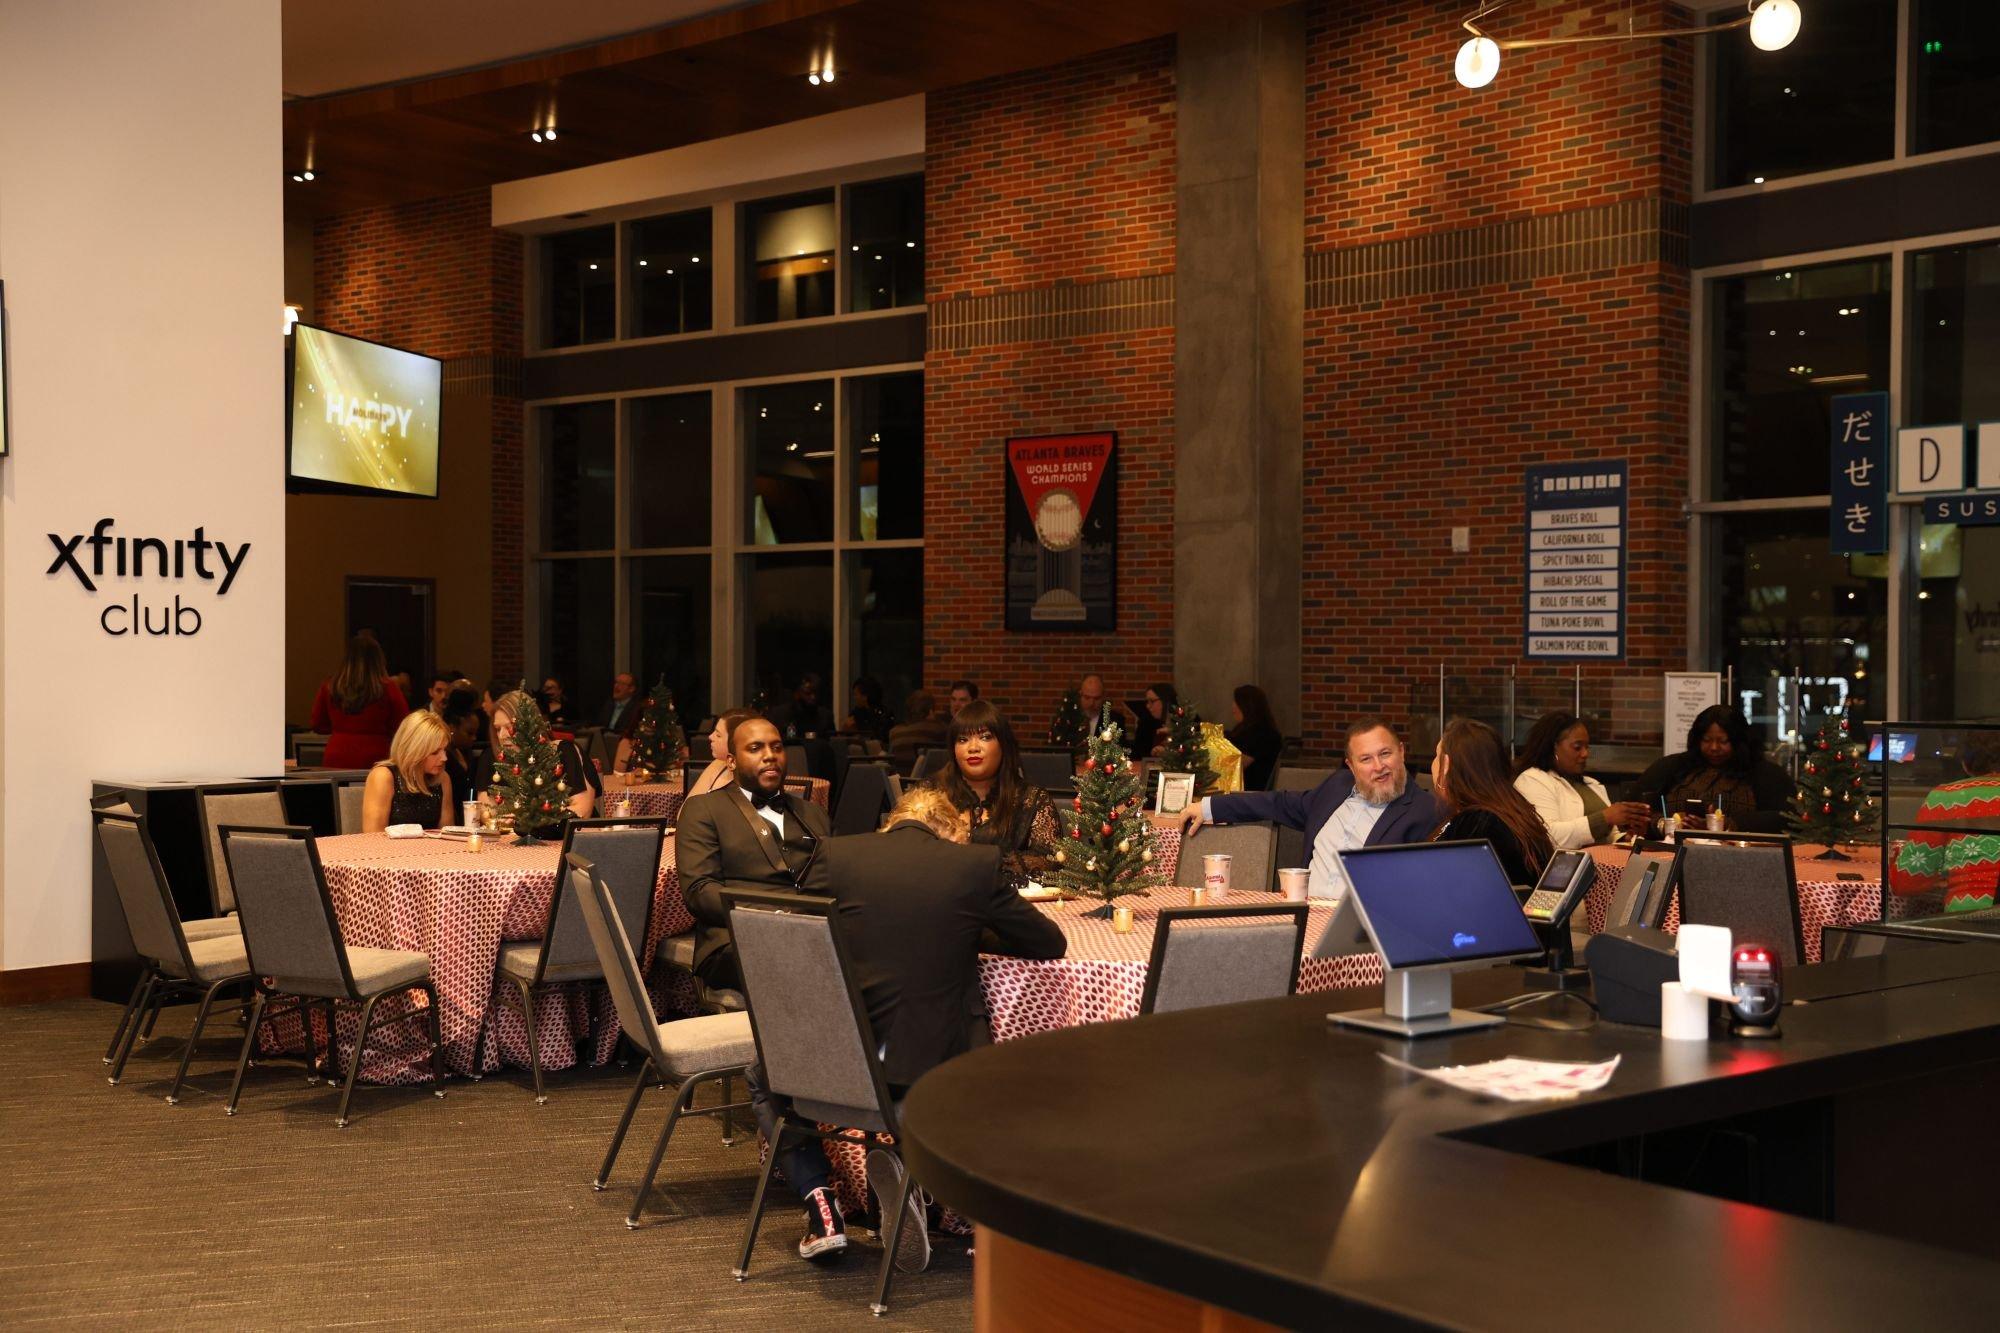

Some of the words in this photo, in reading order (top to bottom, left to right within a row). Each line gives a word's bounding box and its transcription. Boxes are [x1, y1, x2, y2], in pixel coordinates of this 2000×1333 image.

[325, 391, 413, 438] HAPPY
[1015, 446, 1060, 462] ATLANTA
[1064, 444, 1105, 459] BRAVES
[1026, 463, 1059, 474] WORLD
[1062, 461, 1094, 473] SERIES
[1841, 410, 1874, 534] だせき
[1031, 472, 1088, 485] CHAMPIONS
[1550, 512, 1579, 524] BRAVES
[1580, 512, 1598, 523] ROLL
[1543, 534, 1585, 546] CALIFORNIA
[1586, 532, 1605, 544] ROLL
[46, 517, 252, 596] xfinity
[1542, 554, 1564, 567] SPICY
[1565, 554, 1584, 566] TUNA
[1586, 553, 1605, 564] ROLL
[1543, 575, 1573, 587] HIBACHI
[1574, 574, 1604, 586] SPECIAL
[1540, 596, 1558, 608] ROLL
[1559, 596, 1569, 607] OF
[1571, 595, 1584, 607] THE
[1586, 595, 1607, 607] GAME
[100, 593, 202, 636] club
[1541, 617, 1561, 628] TUNA
[1562, 616, 1581, 628] POKE
[1583, 616, 1605, 628] BOWL
[1535, 639, 1565, 651] SALMON
[1566, 638, 1585, 650] POKE
[1587, 638, 1609, 650] BOWL
